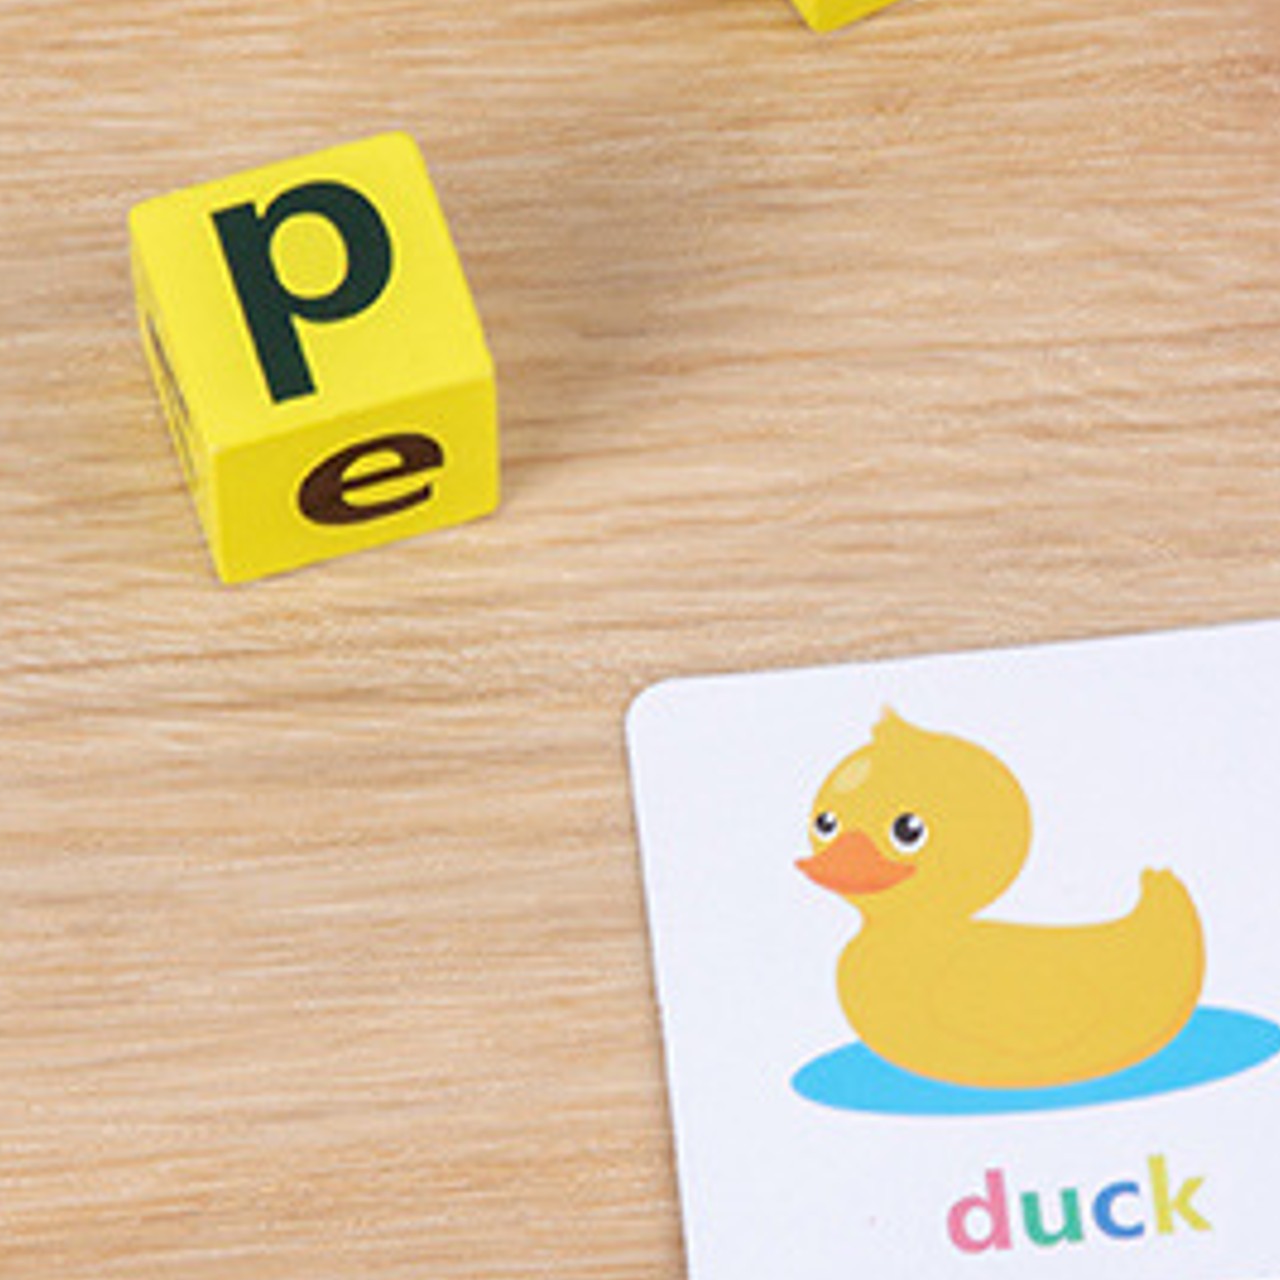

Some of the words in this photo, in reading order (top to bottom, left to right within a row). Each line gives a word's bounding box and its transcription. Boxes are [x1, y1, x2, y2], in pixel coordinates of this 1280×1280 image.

[211, 180, 394, 404] p
[297, 432, 444, 526] e
[946, 1153, 1213, 1254] duck
